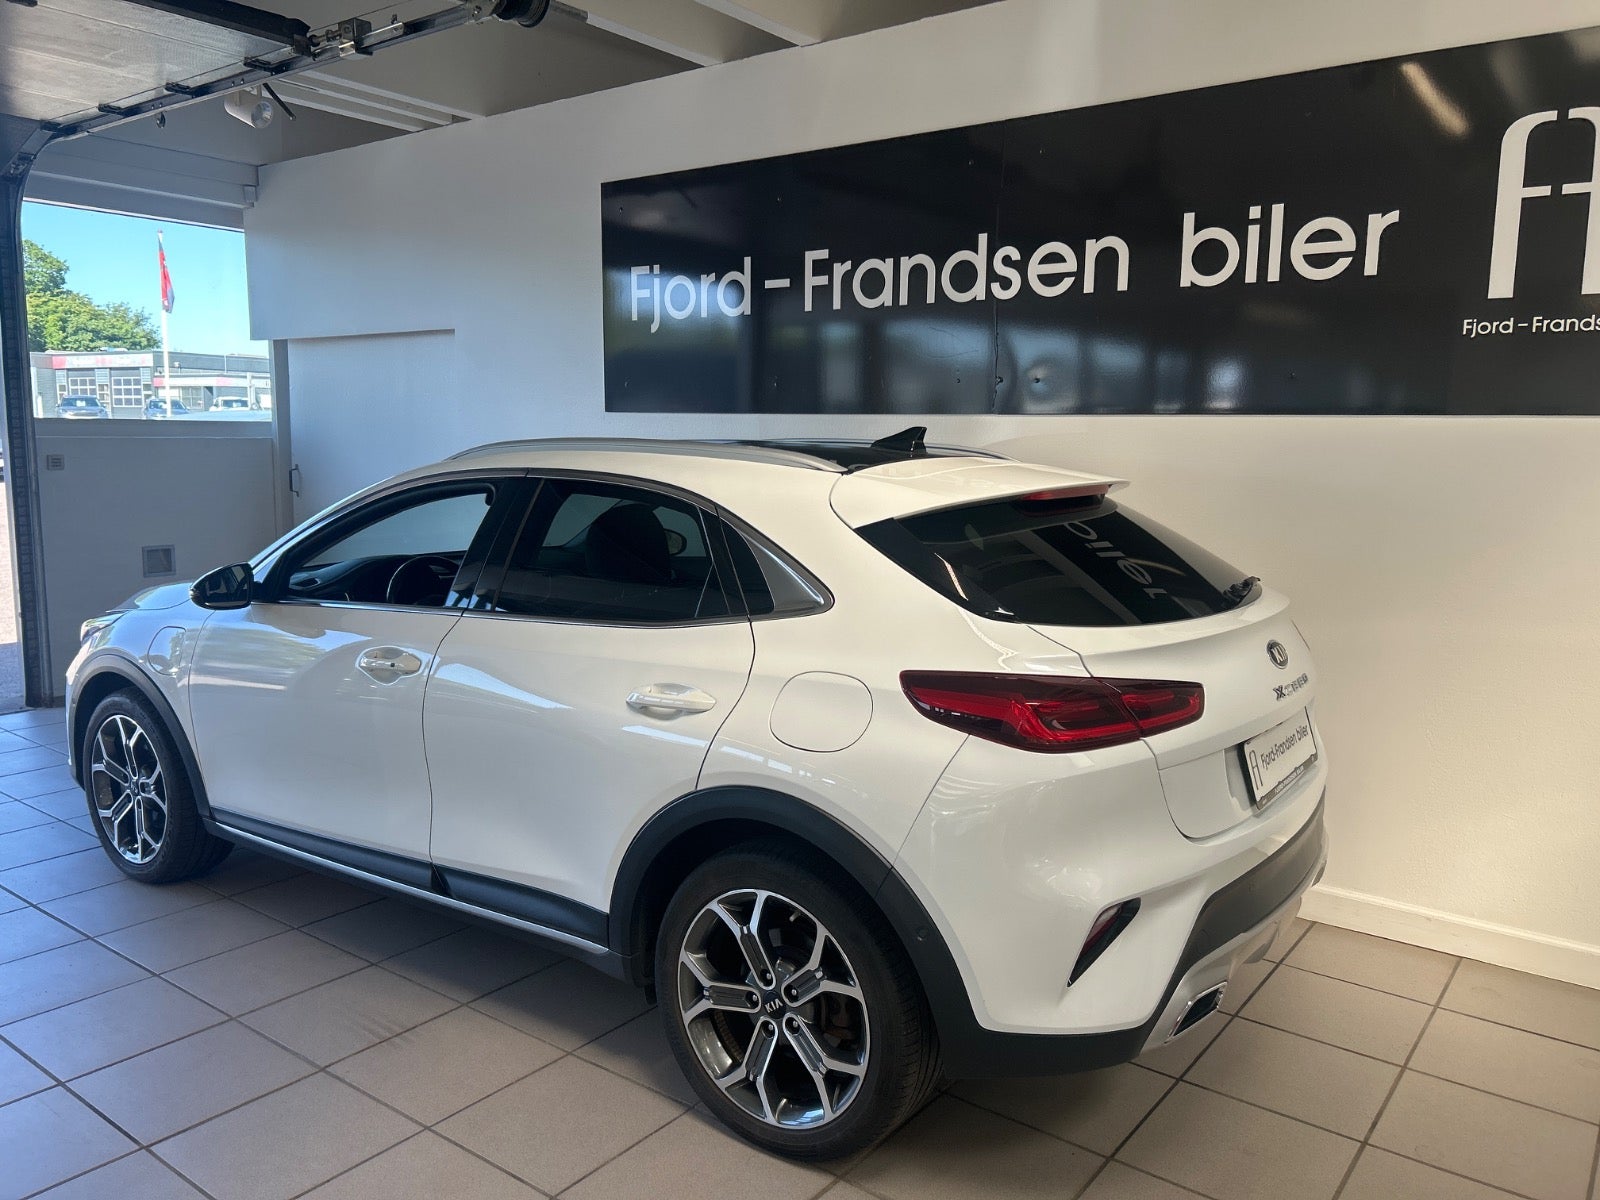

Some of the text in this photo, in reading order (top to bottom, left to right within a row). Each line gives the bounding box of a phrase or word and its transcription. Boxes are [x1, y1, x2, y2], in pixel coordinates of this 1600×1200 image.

[629, 256, 752, 334] Fjord
[803, 232, 1130, 312] Frandsen
[1179, 202, 1400, 288] biler
[1462, 316, 1514, 338] Fjord
[764, 998, 784, 1013] KIA
